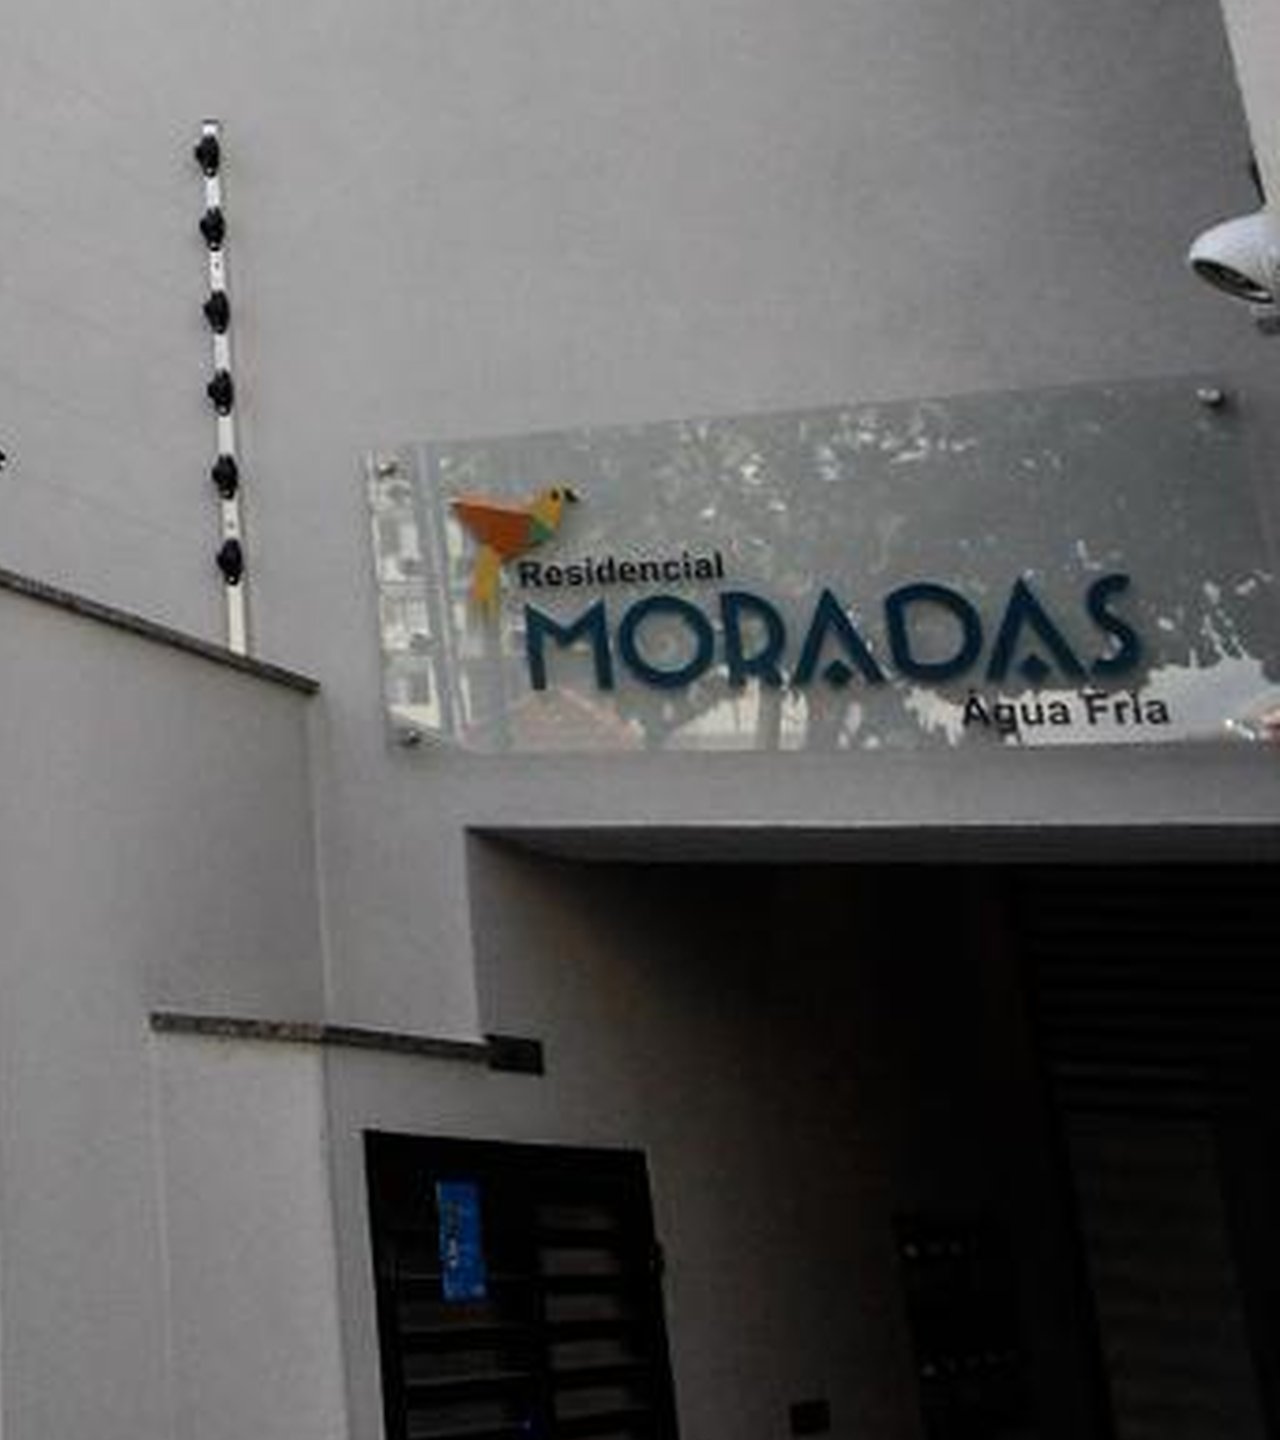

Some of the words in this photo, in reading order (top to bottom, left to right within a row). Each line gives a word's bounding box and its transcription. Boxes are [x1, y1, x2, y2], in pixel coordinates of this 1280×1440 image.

[518, 550, 725, 588] Residencial
[523, 573, 1143, 692] MORADAS
[1083, 690, 1170, 726] Fria
